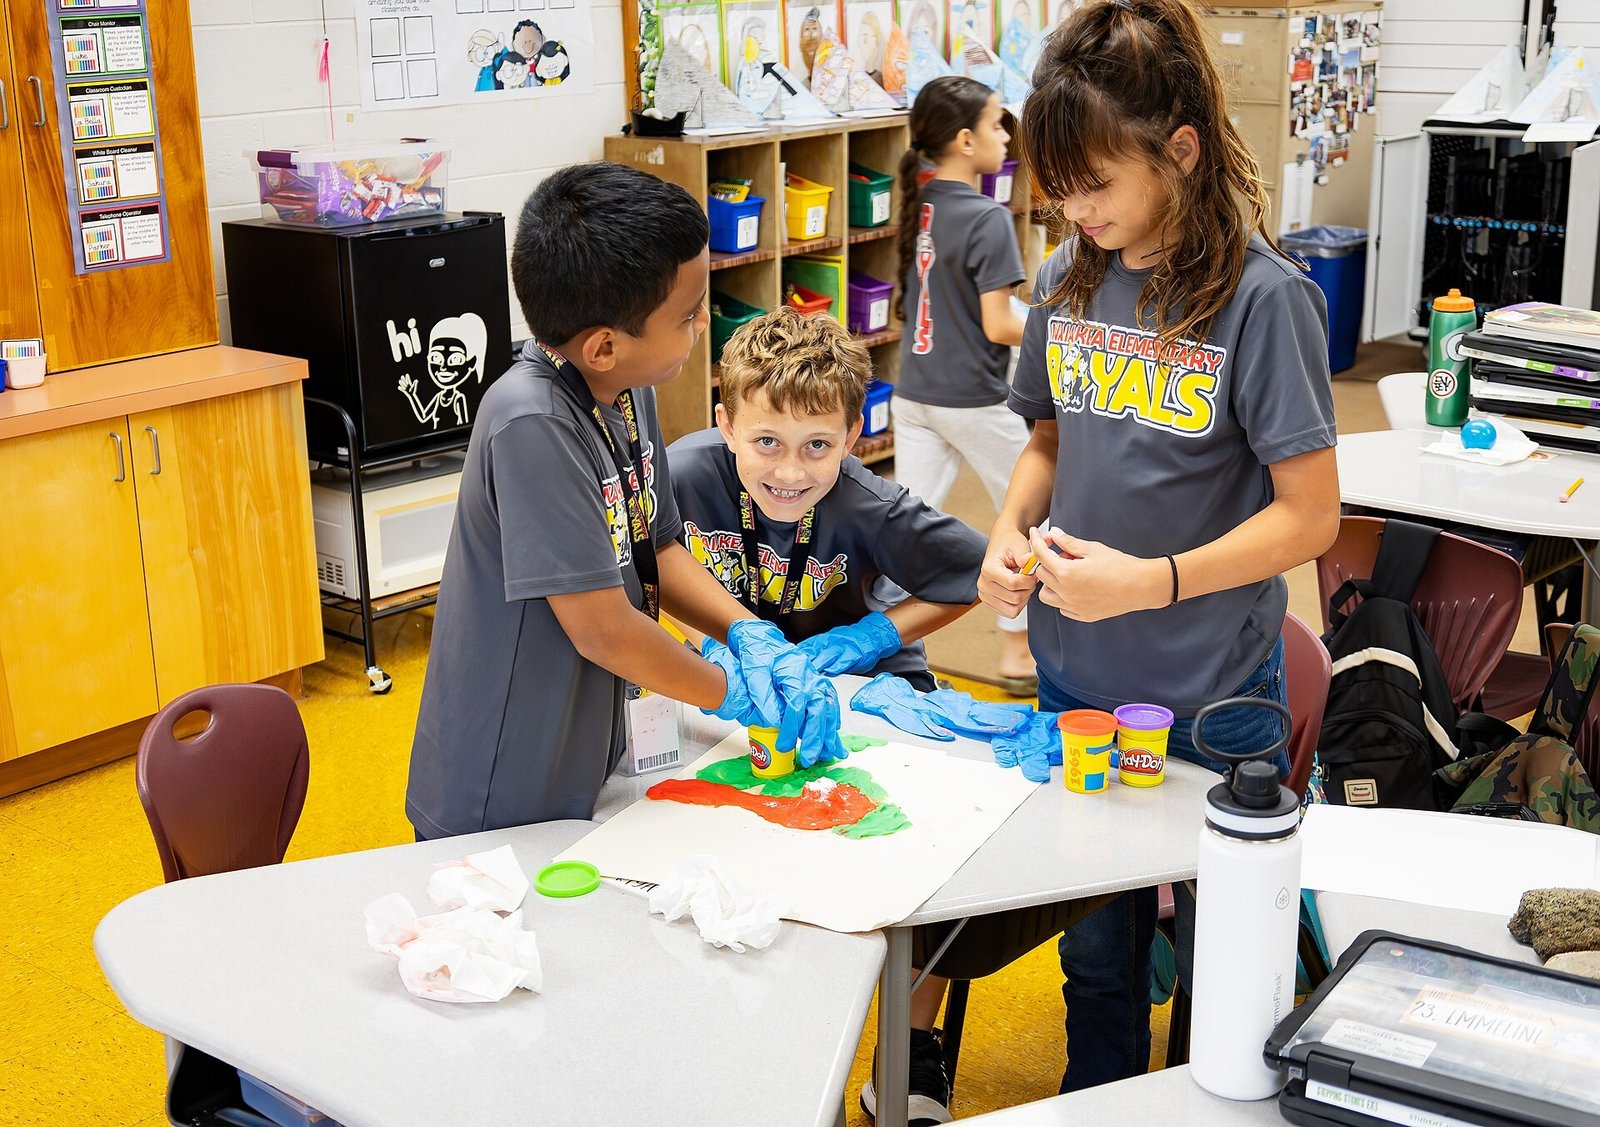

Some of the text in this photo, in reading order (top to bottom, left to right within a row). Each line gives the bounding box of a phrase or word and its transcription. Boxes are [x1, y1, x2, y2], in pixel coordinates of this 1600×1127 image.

[98, 209, 142, 220] Telephone Operator
[386, 318, 422, 362] hi
[1107, 331, 1222, 373] ELEMENTARY
[1047, 344, 1217, 432] RYALS
[1069, 746, 1082, 787] 1965
[1119, 750, 1163, 771] Play-Doh
[1273, 973, 1282, 1029] ermoFlask
